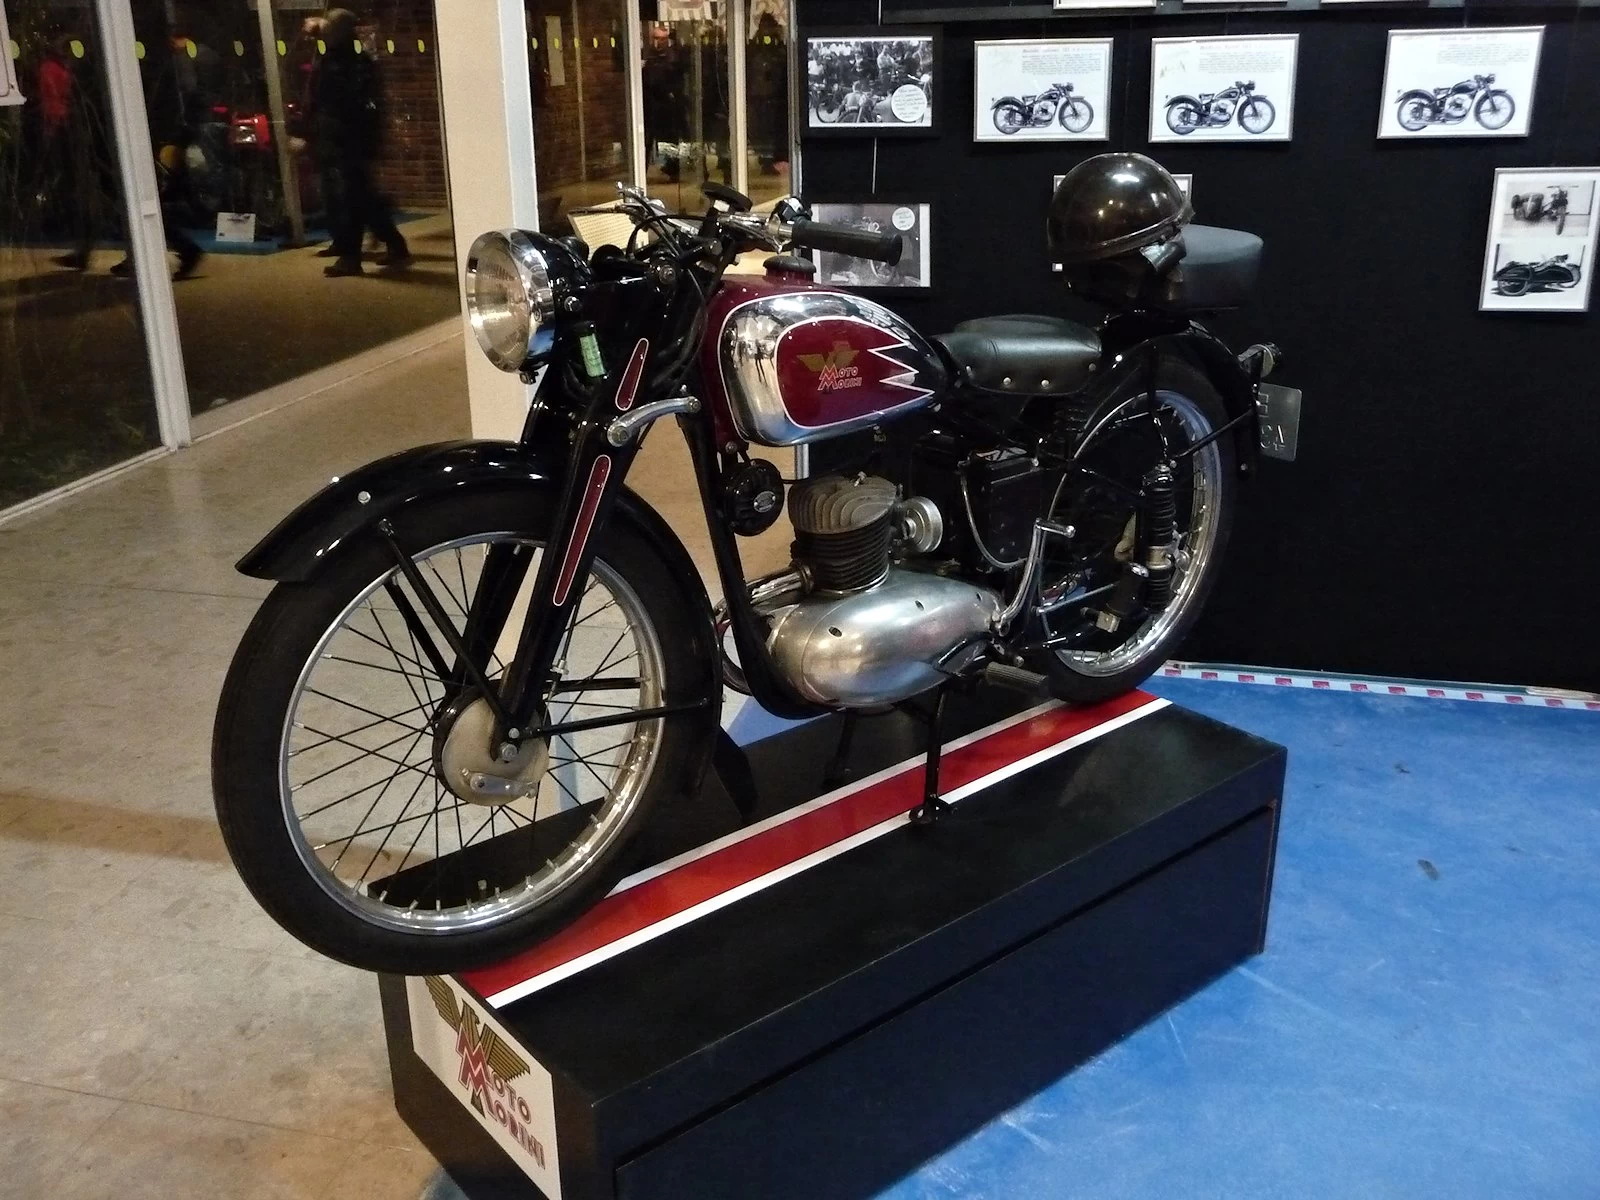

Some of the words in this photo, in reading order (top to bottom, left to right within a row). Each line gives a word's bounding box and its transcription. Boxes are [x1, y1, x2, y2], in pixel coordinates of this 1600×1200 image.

[818, 376, 863, 391] MORINI
[819, 364, 858, 379] MOTO
[457, 1025, 531, 1124] MOTO
[458, 1047, 546, 1169] MORINI
